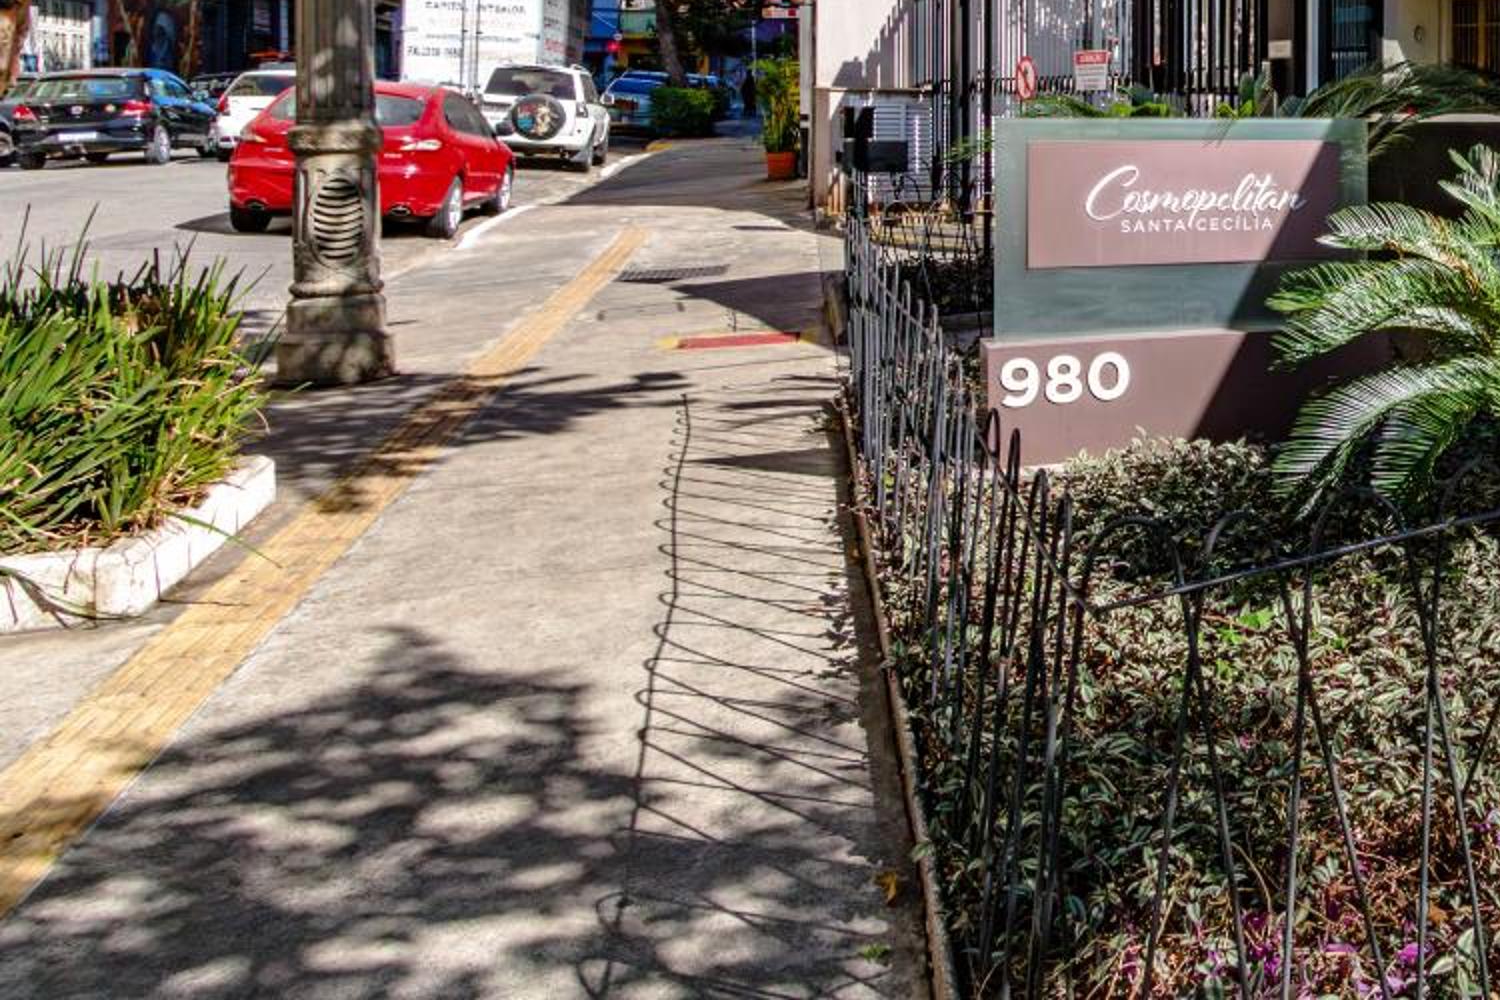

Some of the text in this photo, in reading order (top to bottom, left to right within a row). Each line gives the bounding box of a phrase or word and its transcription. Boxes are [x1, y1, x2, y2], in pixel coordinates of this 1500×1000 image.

[1085, 164, 1307, 229] Cosmopolitan
[1120, 215, 1274, 233] SANTA CECÍLIA
[999, 351, 1131, 407] 980
